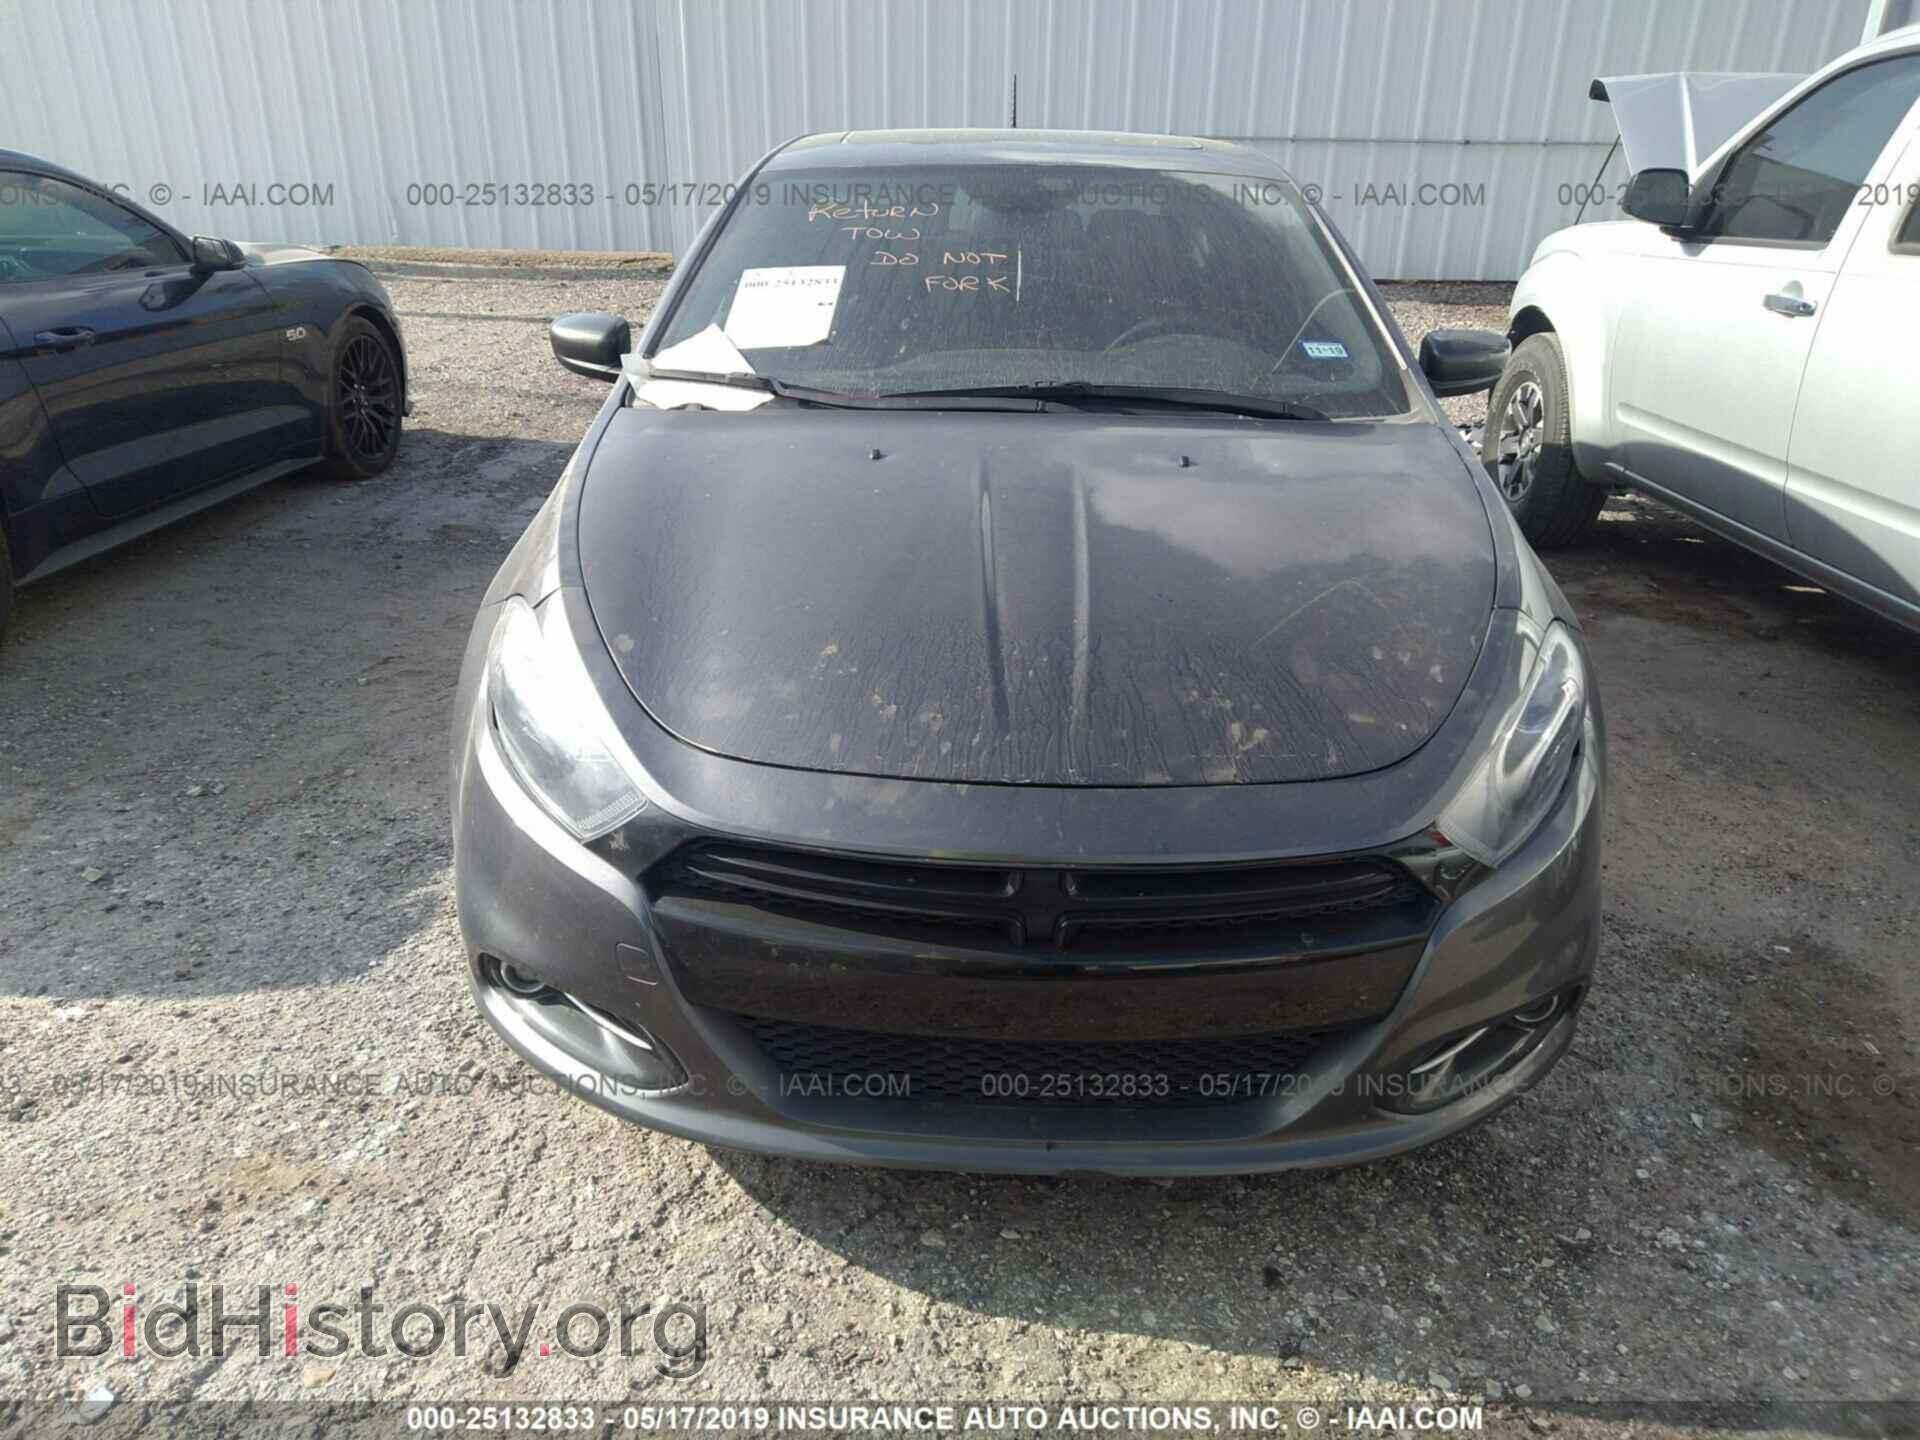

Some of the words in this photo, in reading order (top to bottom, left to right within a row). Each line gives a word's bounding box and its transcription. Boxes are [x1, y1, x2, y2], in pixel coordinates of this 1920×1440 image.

[840, 226, 921, 241] TOW
[869, 250, 920, 266] DO
[942, 251, 1008, 266] NOT
[924, 274, 1011, 294] FORK
